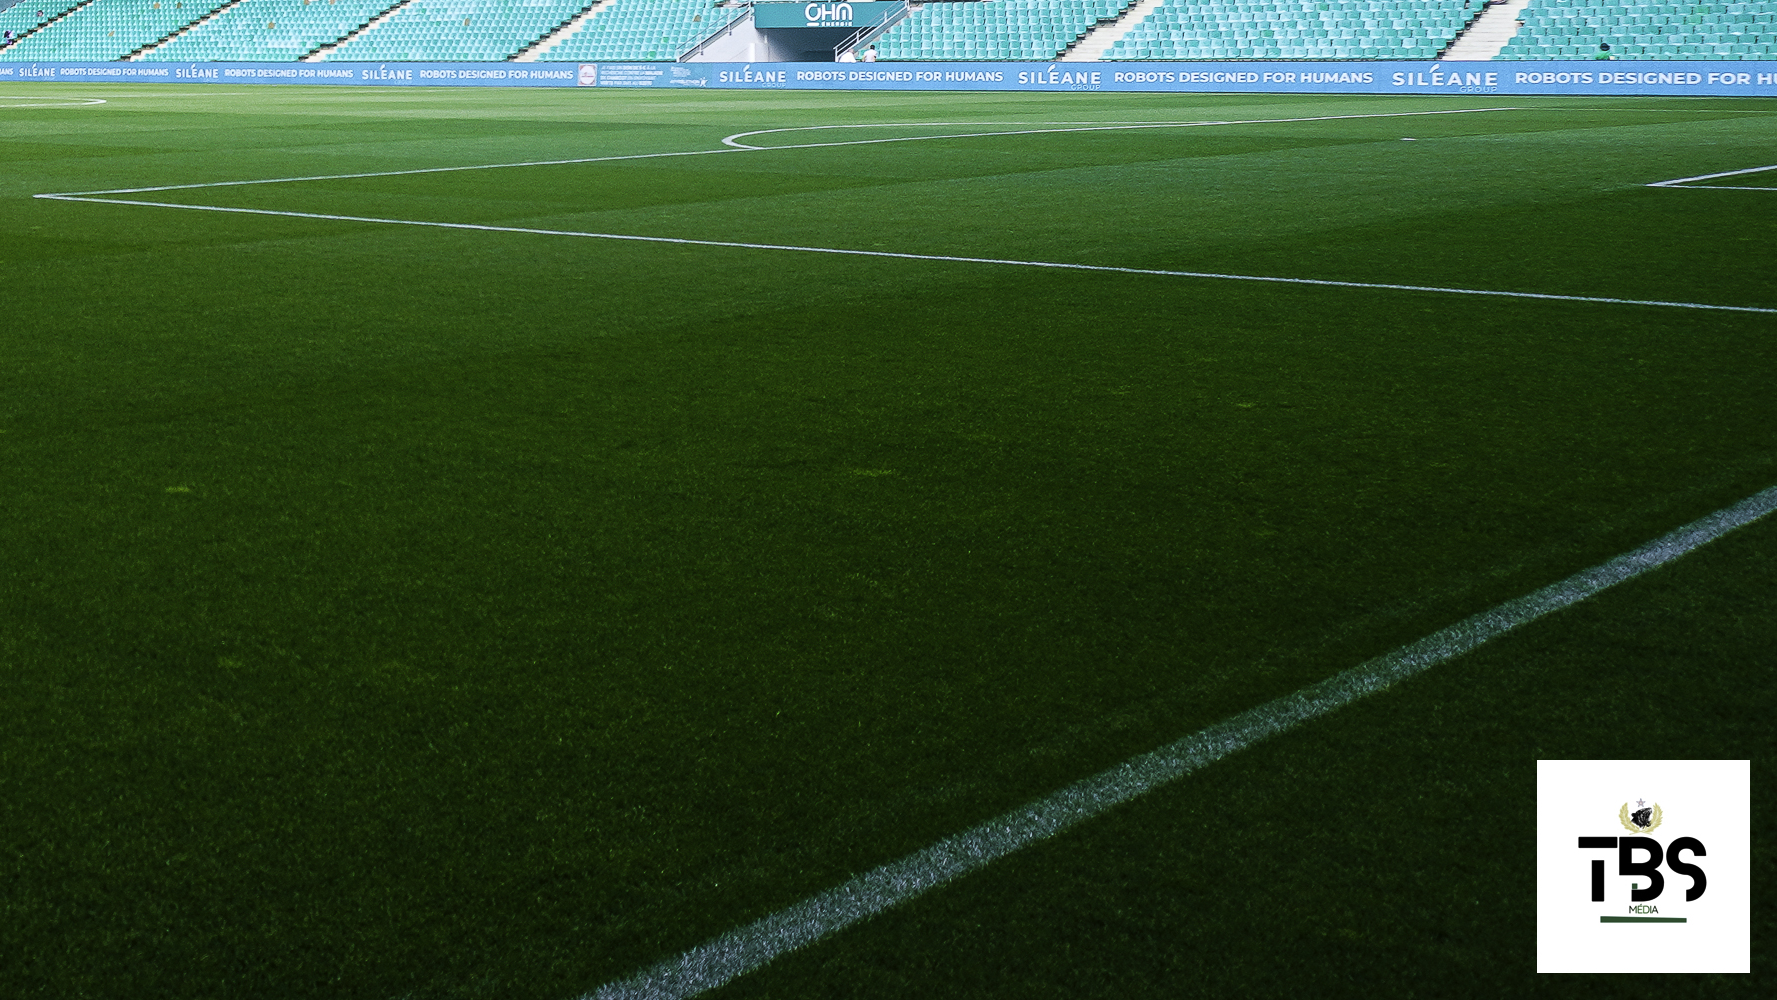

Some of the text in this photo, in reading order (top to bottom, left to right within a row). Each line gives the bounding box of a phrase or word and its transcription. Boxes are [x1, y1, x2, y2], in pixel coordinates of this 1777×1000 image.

[59, 67, 169, 76] ROBOTS DESIGNED FOR HUMANS
[224, 68, 354, 78] ROBOTS DESIGNED FOR HUMANS
[420, 69, 458, 79] ROBOTS
[458, 69, 505, 79] DESIGNED
[508, 70, 528, 79] FOR
[529, 70, 574, 80] HUMANS
[797, 71, 1003, 82] ROBOTS DESIGNED FOR HUMANS
[1114, 72, 1373, 83] ROBOTS DESIGNED FOR HUMANS
[1515, 72, 1593, 84] ROBOTS
[1598, 72, 1702, 85] DESIGNED
[1708, 72, 1751, 85] FOR
